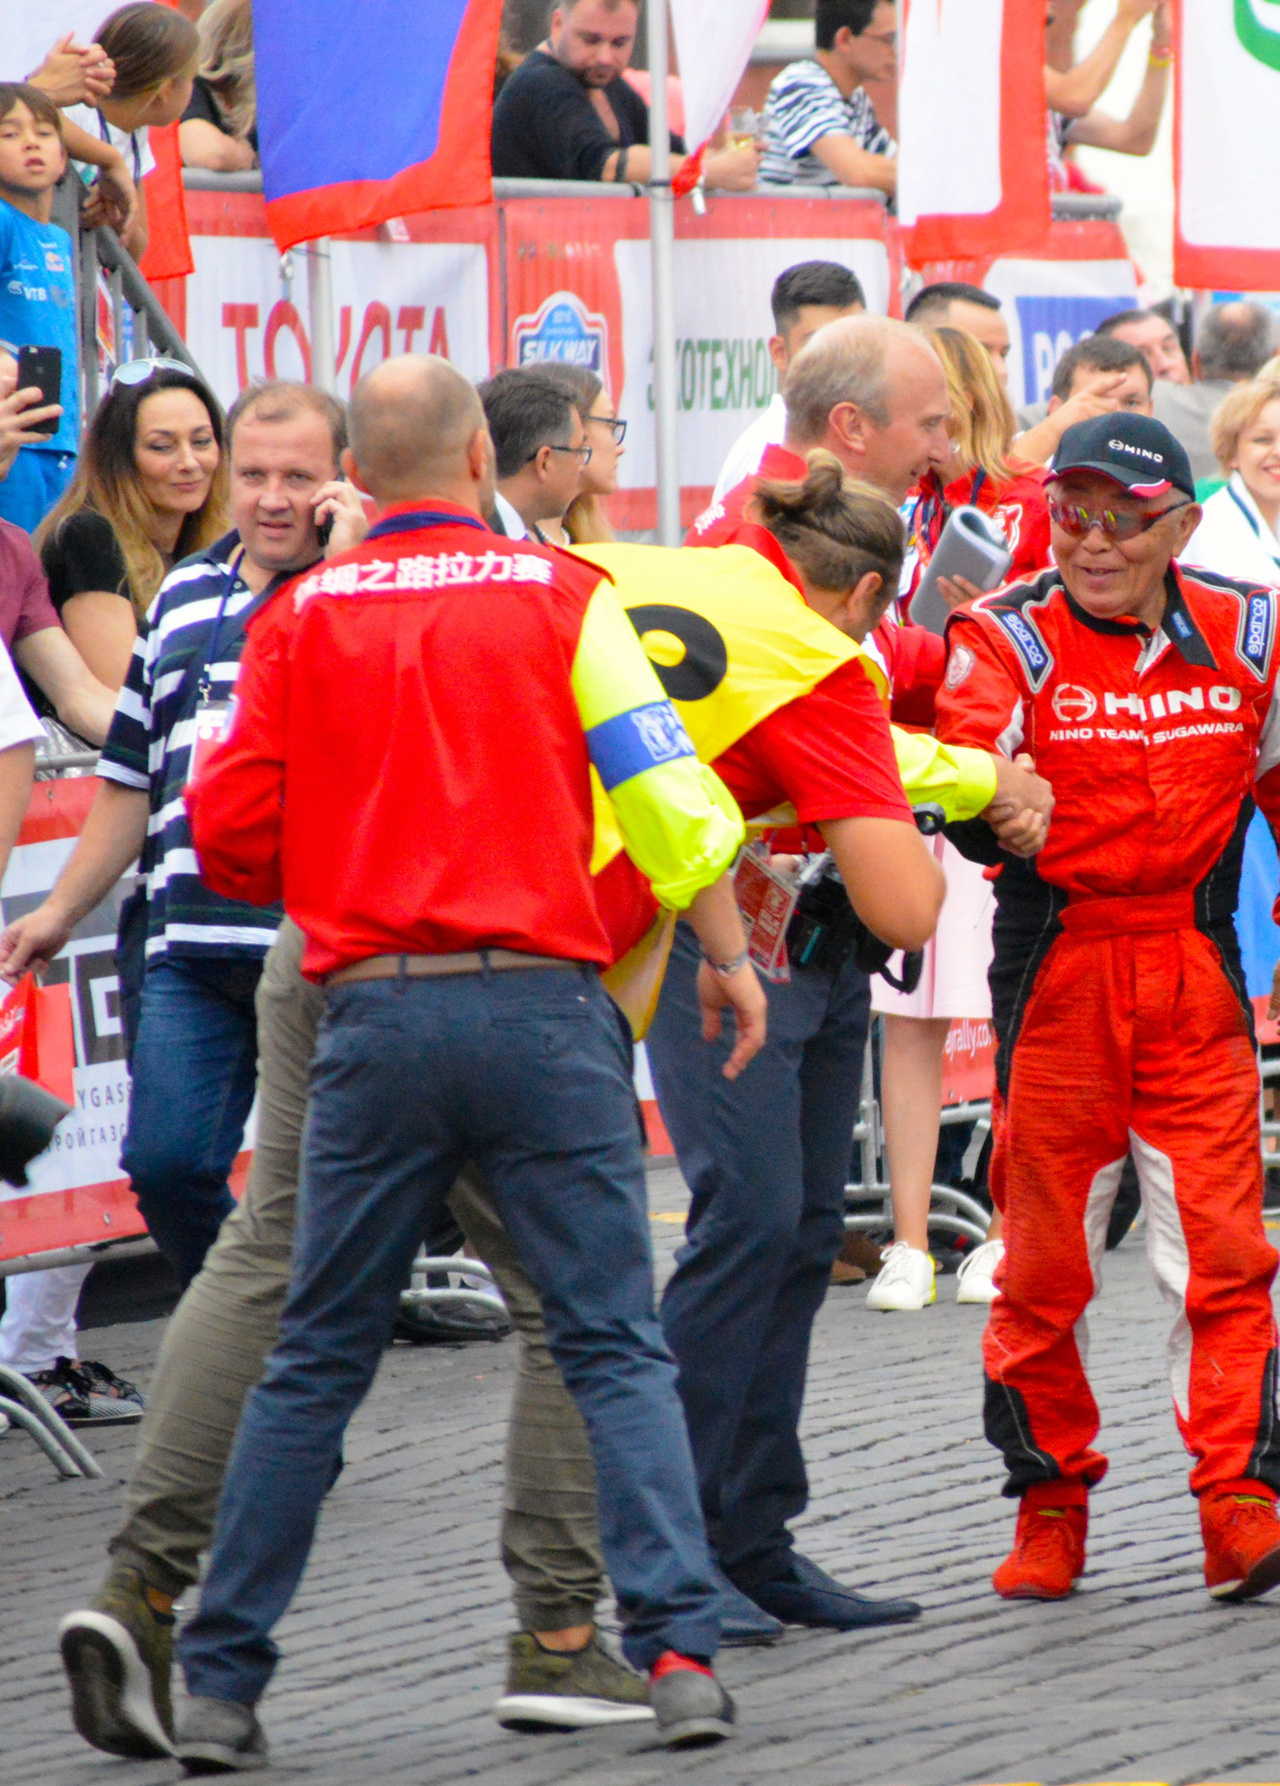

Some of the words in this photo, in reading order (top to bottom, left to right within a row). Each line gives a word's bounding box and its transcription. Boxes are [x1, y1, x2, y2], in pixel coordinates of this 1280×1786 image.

[1124, 443, 1164, 464] HINO
[1104, 685, 1242, 722] HINO
[1050, 727, 1093, 741] HINO
[1097, 727, 1150, 746] TEAM
[1153, 722, 1245, 744] SUGAWARA
